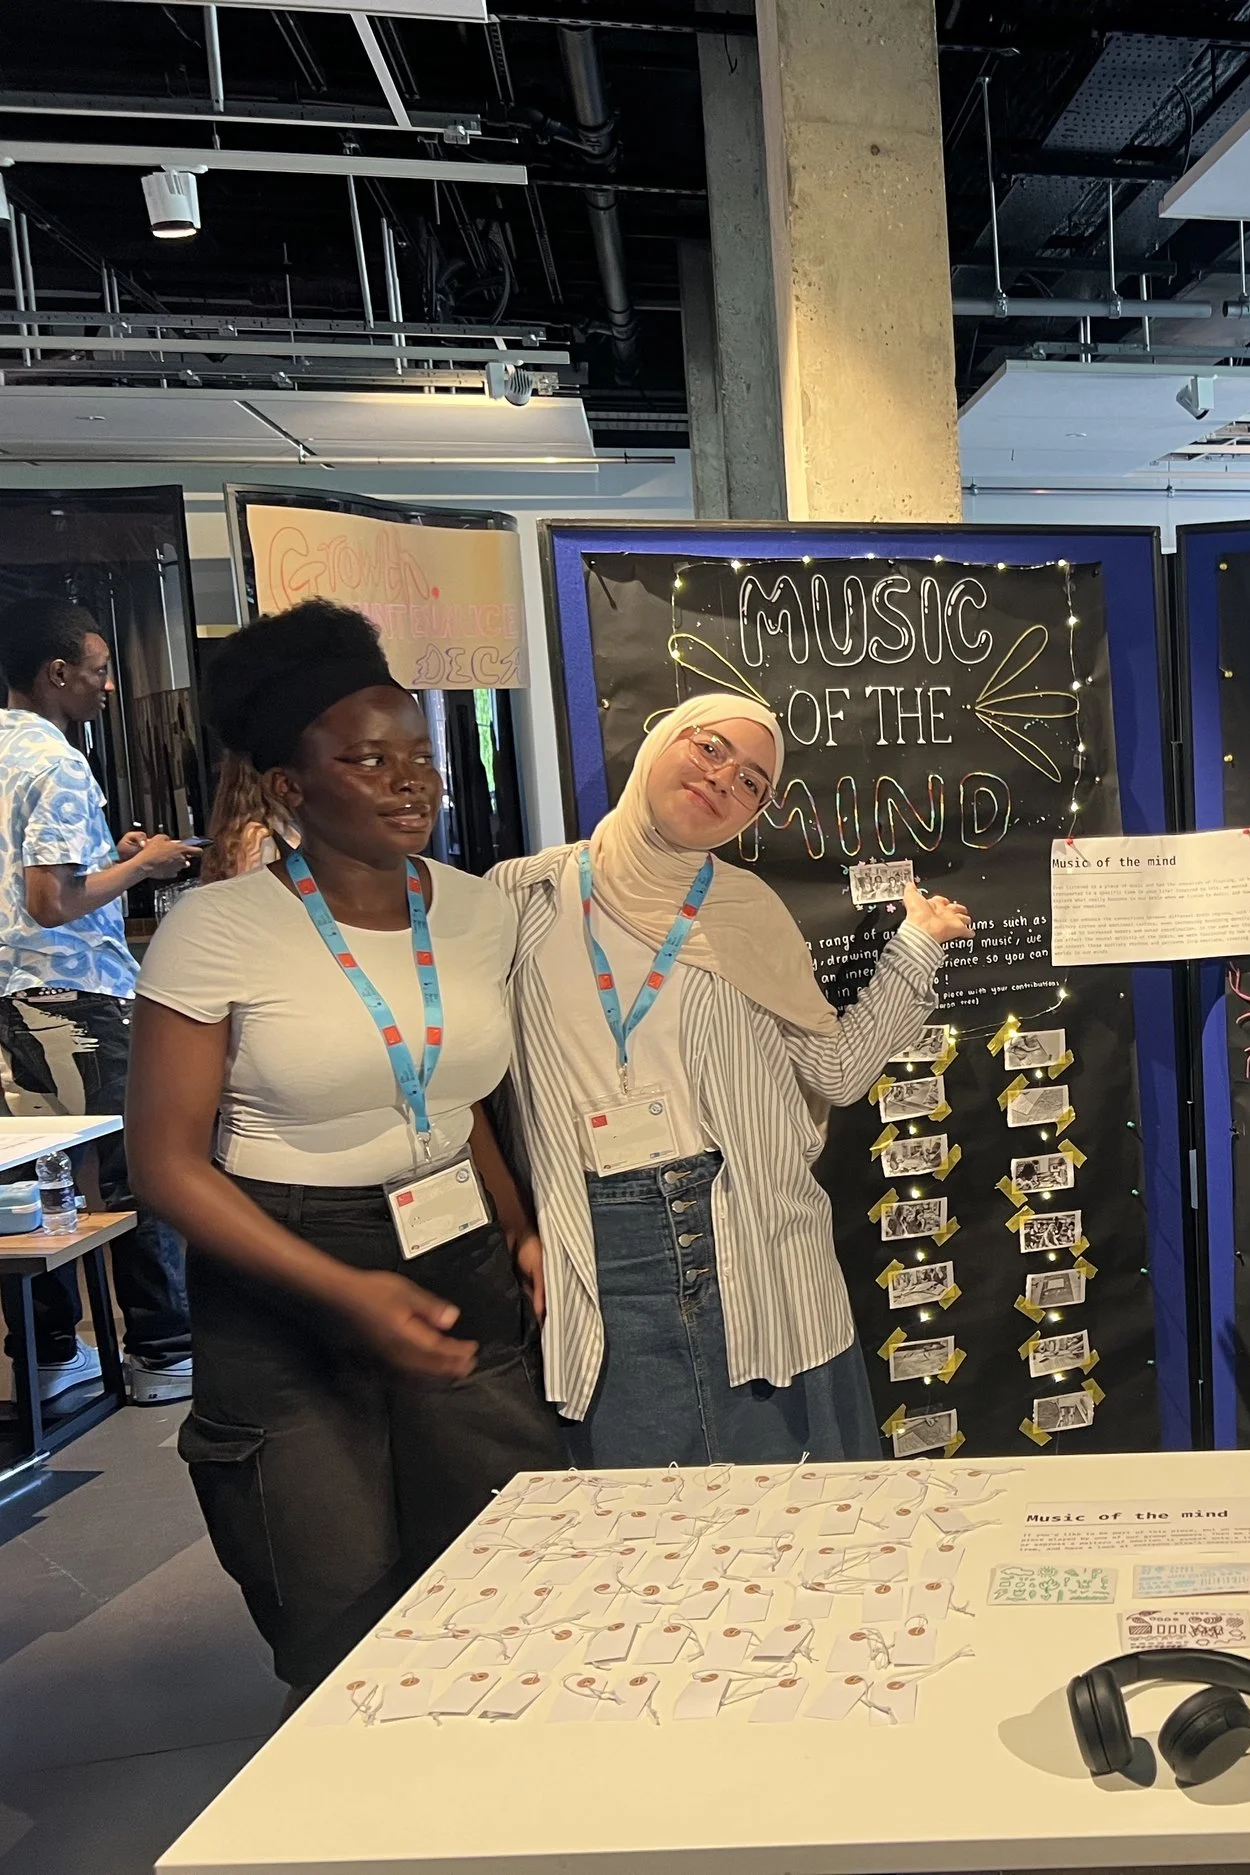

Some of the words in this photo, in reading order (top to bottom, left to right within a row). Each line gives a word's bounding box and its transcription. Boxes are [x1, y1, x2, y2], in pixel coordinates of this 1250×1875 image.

[739, 573, 993, 667] MUSIC
[788, 688, 849, 747] OF
[865, 686, 953, 745] THE
[738, 771, 1011, 862] MIND
[1052, 857, 1088, 869] Music
[1097, 857, 1111, 868] of
[1119, 857, 1140, 867] the
[1148, 855, 1177, 867] mind
[1003, 916, 1028, 928] such
[1033, 916, 1047, 925] as
[819, 934, 856, 952] range
[863, 928, 877, 940] of
[942, 939, 974, 954] ucing
[1026, 934, 1042, 944] we
[827, 949, 880, 966] drawing
[939, 955, 979, 968] erience
[986, 954, 999, 964] so
[1005, 951, 1025, 965] you
[1029, 949, 1049, 960] can
[821, 974, 837, 984] an
[846, 968, 875, 980] inter
[968, 987, 987, 996] with
[991, 986, 1008, 995] your
[1011, 981, 1060, 991] contributions
[1026, 1513, 1086, 1523] Music
[1098, 1512, 1123, 1521] of
[1135, 1511, 1169, 1520] the
[1181, 1509, 1228, 1519] mind
